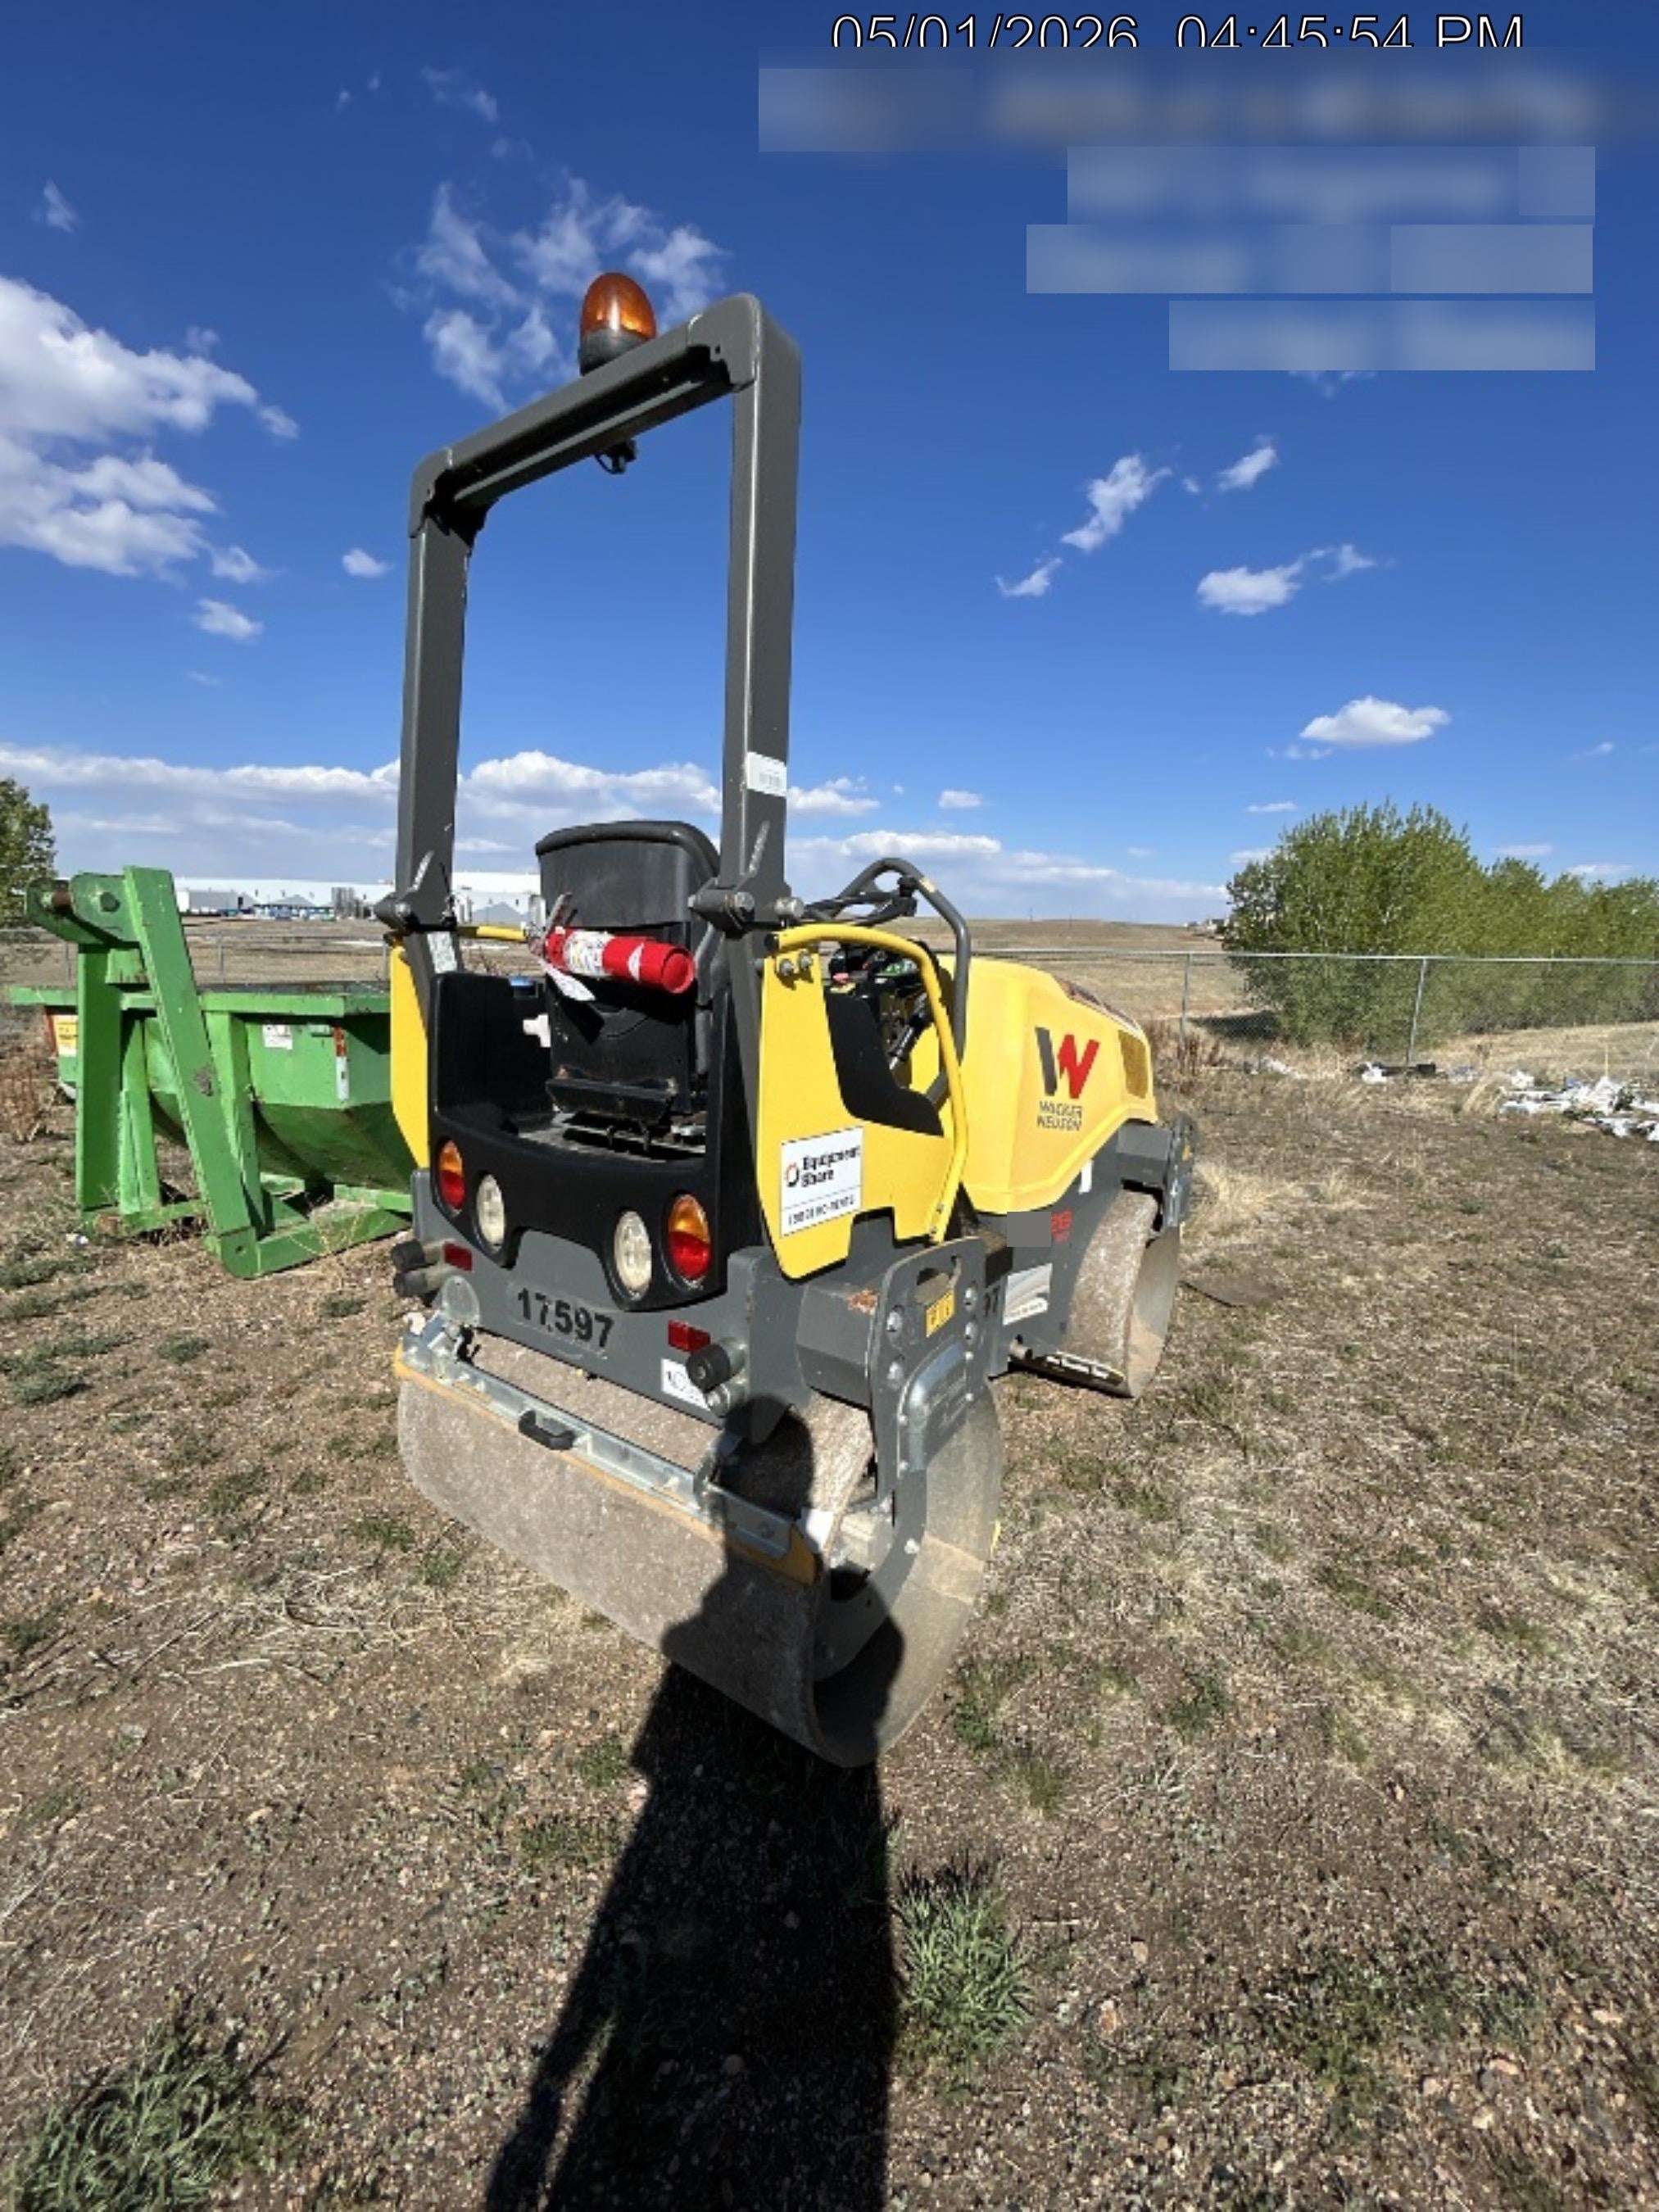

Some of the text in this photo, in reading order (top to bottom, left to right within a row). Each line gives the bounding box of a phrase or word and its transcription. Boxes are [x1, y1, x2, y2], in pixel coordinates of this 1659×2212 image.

[1035, 1027, 1100, 1099] W
[1039, 1100, 1082, 1119] WACKER
[1036, 1114, 1082, 1131] NEUSON
[802, 1145, 861, 1171] Equipment
[801, 1169, 834, 1188] Share
[518, 1287, 614, 1348] 17597
